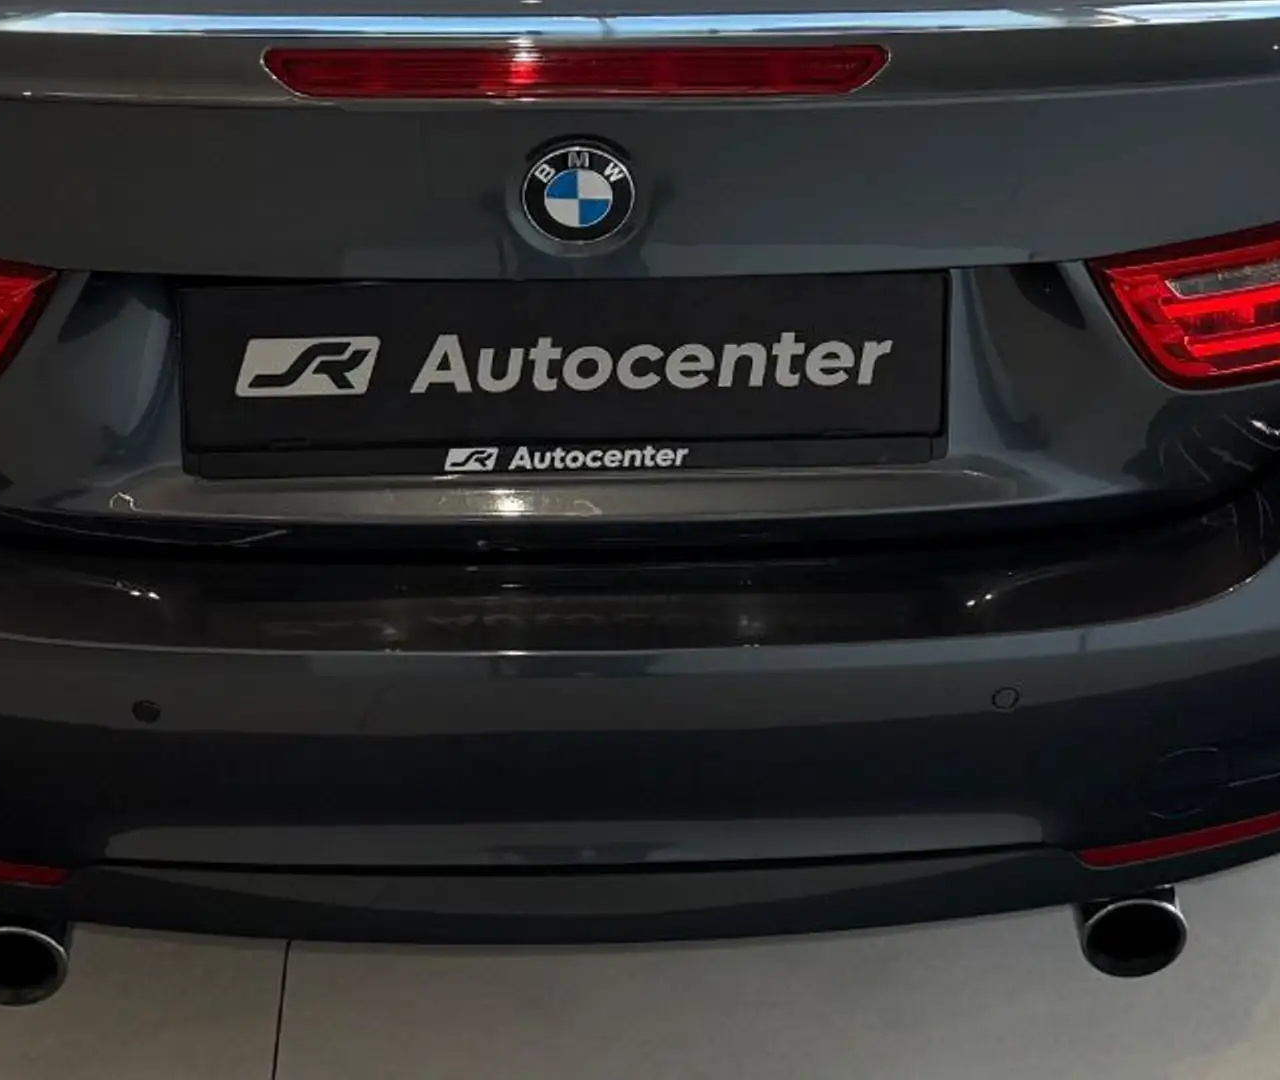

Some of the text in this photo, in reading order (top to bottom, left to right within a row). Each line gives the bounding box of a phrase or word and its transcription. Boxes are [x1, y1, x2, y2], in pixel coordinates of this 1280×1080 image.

[534, 151, 625, 183] BMW
[410, 331, 893, 394] Autocenter
[508, 445, 689, 470] Autocenter
